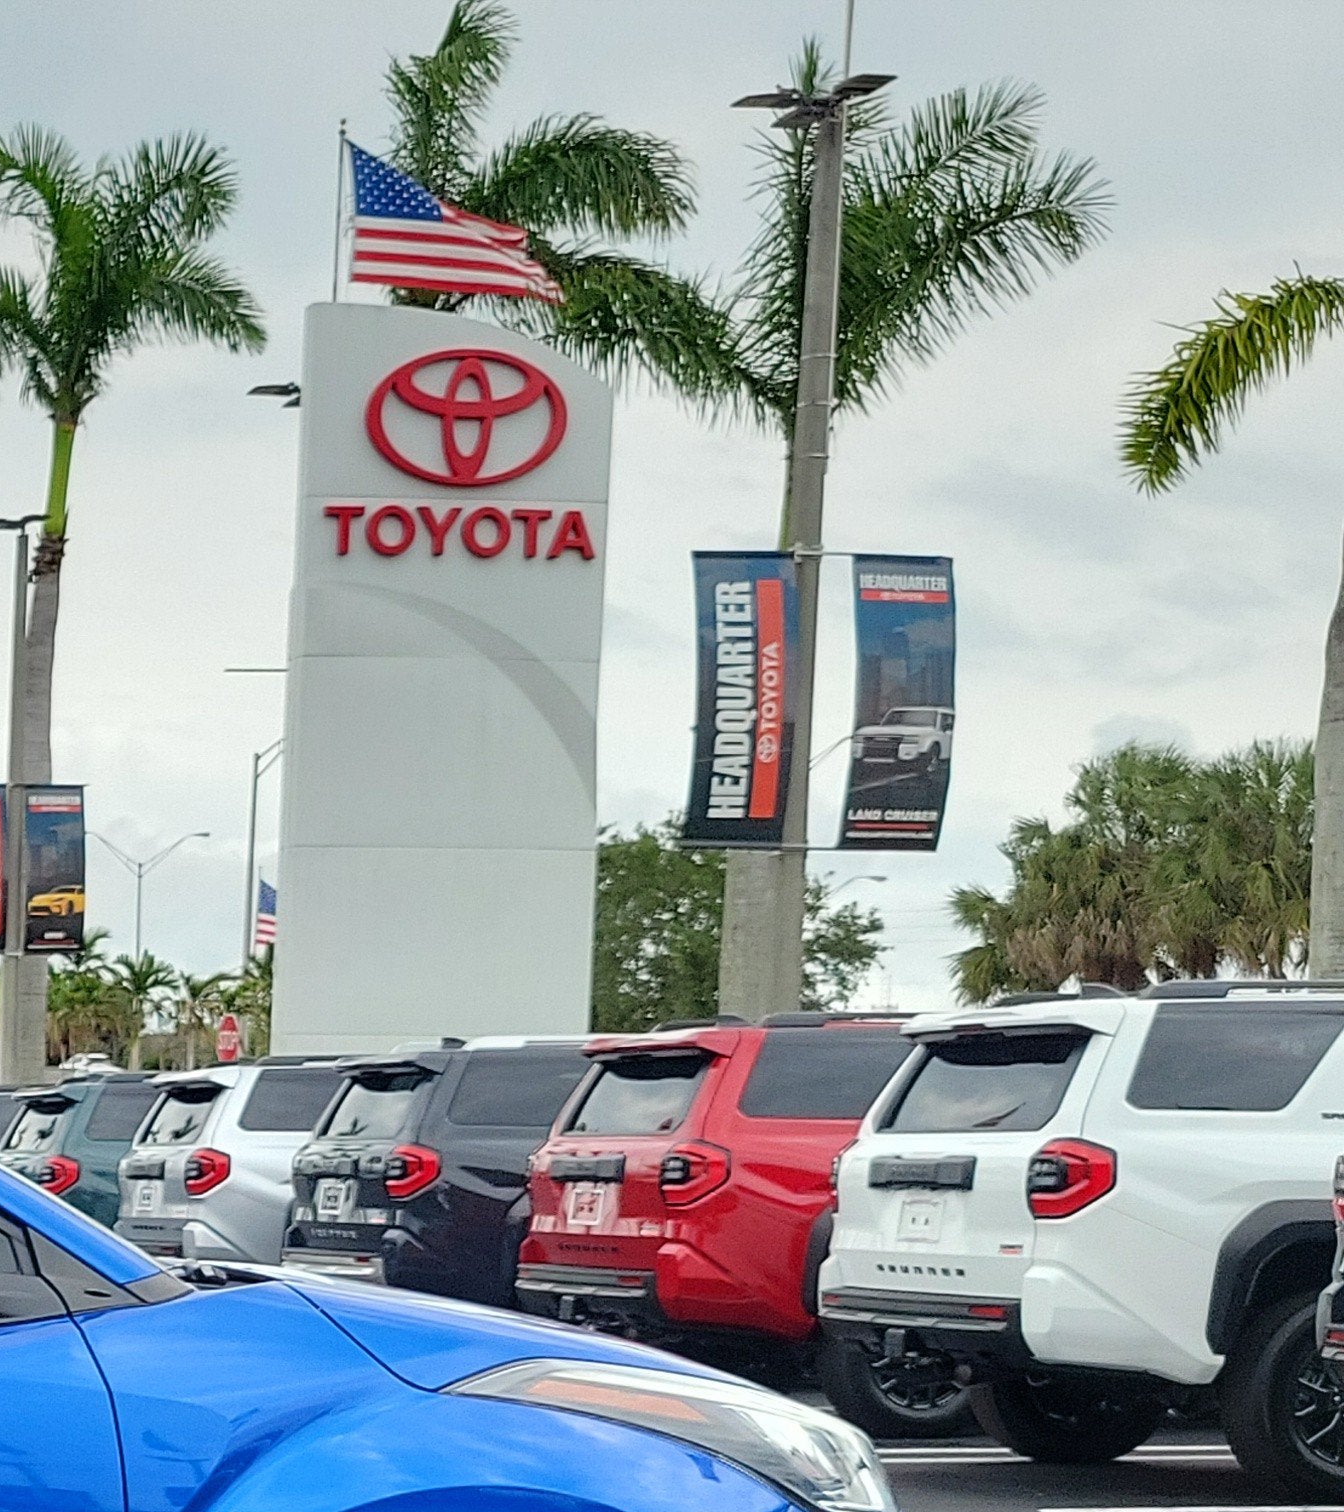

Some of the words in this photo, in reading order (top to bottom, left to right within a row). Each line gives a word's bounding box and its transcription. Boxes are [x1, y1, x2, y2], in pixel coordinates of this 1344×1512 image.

[324, 505, 595, 561] TOYOTA
[707, 581, 757, 819] HEADQUARTER
[761, 641, 779, 731] TOYOTA
